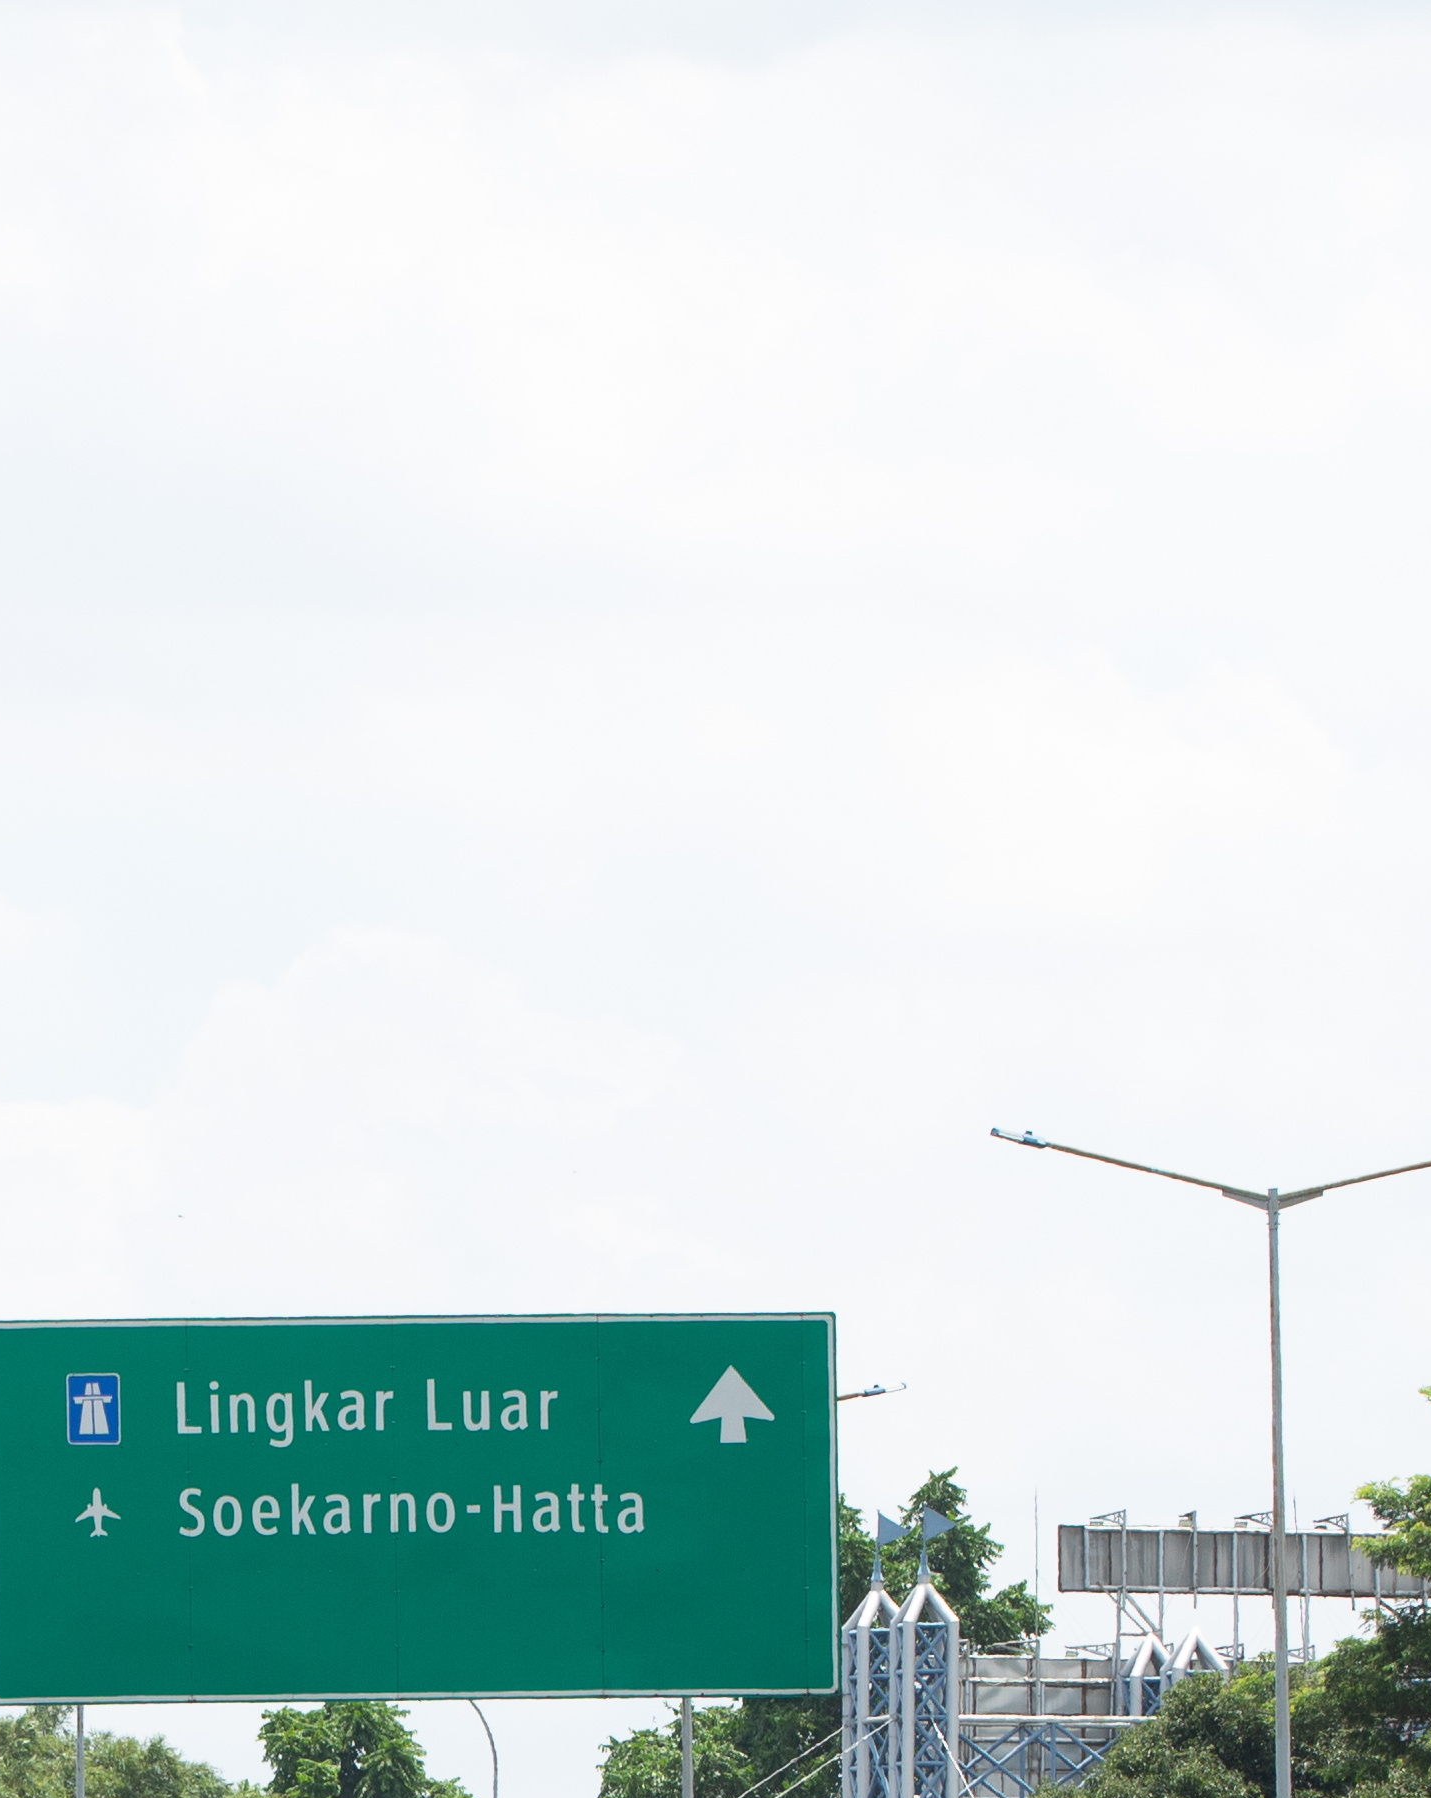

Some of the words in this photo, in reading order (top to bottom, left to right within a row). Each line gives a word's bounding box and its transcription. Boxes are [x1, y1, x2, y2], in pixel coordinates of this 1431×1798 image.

[175, 1379, 395, 1448] Lingkar
[425, 1377, 559, 1432] Luar
[177, 1482, 647, 1538] Soekarno-Hatta
